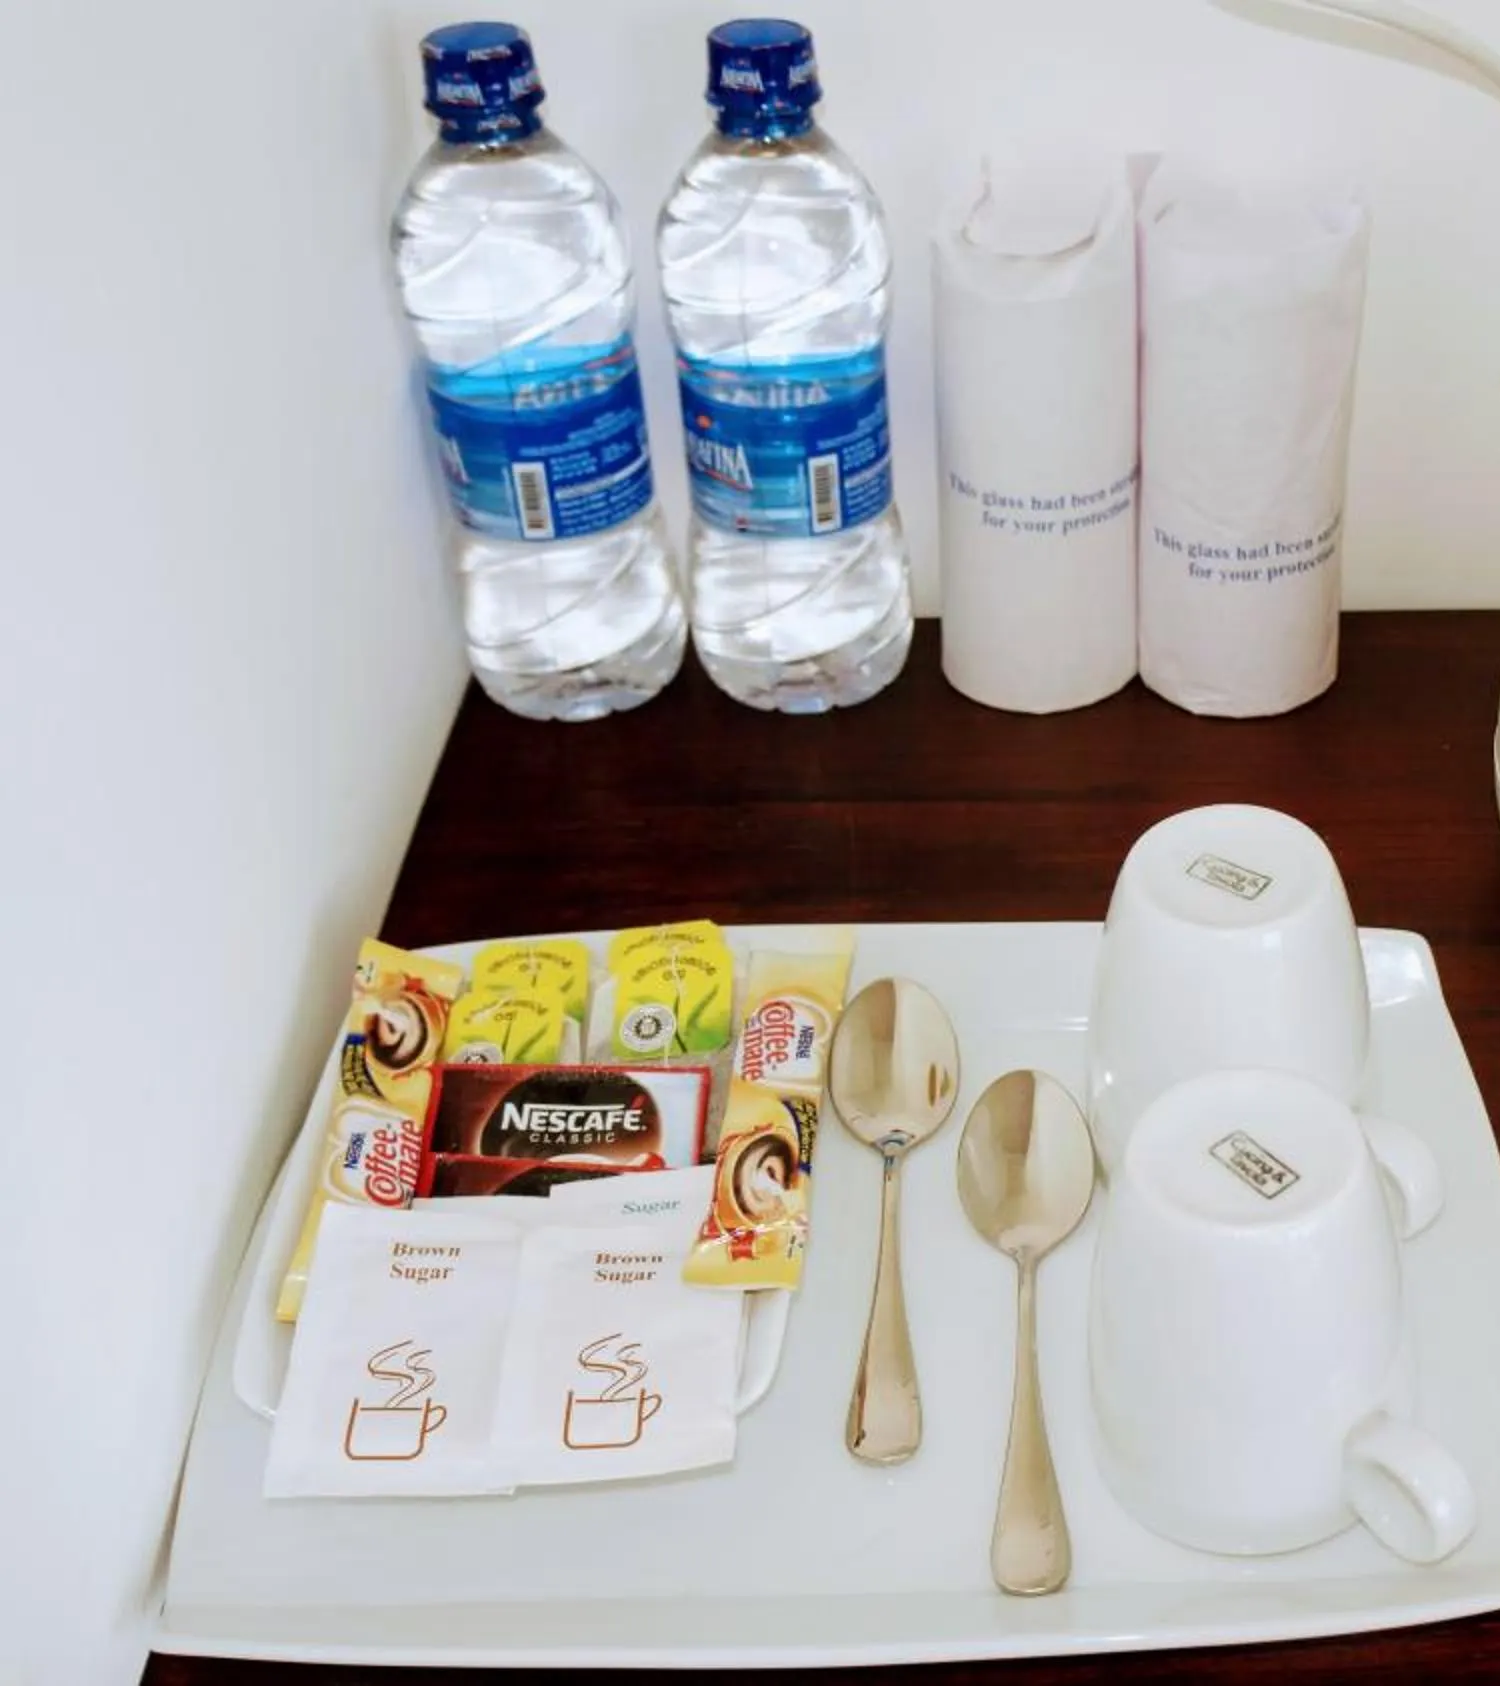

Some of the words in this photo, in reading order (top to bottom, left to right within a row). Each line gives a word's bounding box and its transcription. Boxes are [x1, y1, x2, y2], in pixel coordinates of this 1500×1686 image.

[950, 471, 978, 499] This
[981, 490, 1025, 509] glass
[1030, 496, 1066, 511] had
[1071, 489, 1106, 509] been
[980, 510, 1007, 528] for
[1012, 519, 1057, 536] your
[1153, 526, 1184, 553] This
[1187, 543, 1230, 561] glass
[1237, 544, 1270, 561] had
[1275, 539, 1313, 556] been
[1187, 561, 1213, 579] for
[1219, 569, 1263, 586] your
[529, 1131, 618, 1145] CLASSIC
[620, 1198, 681, 1216] Sugar
[392, 1242, 461, 1258] Brown
[595, 1251, 664, 1265] Brown
[389, 1263, 455, 1285] Sugar
[593, 1269, 657, 1285] Sugar
